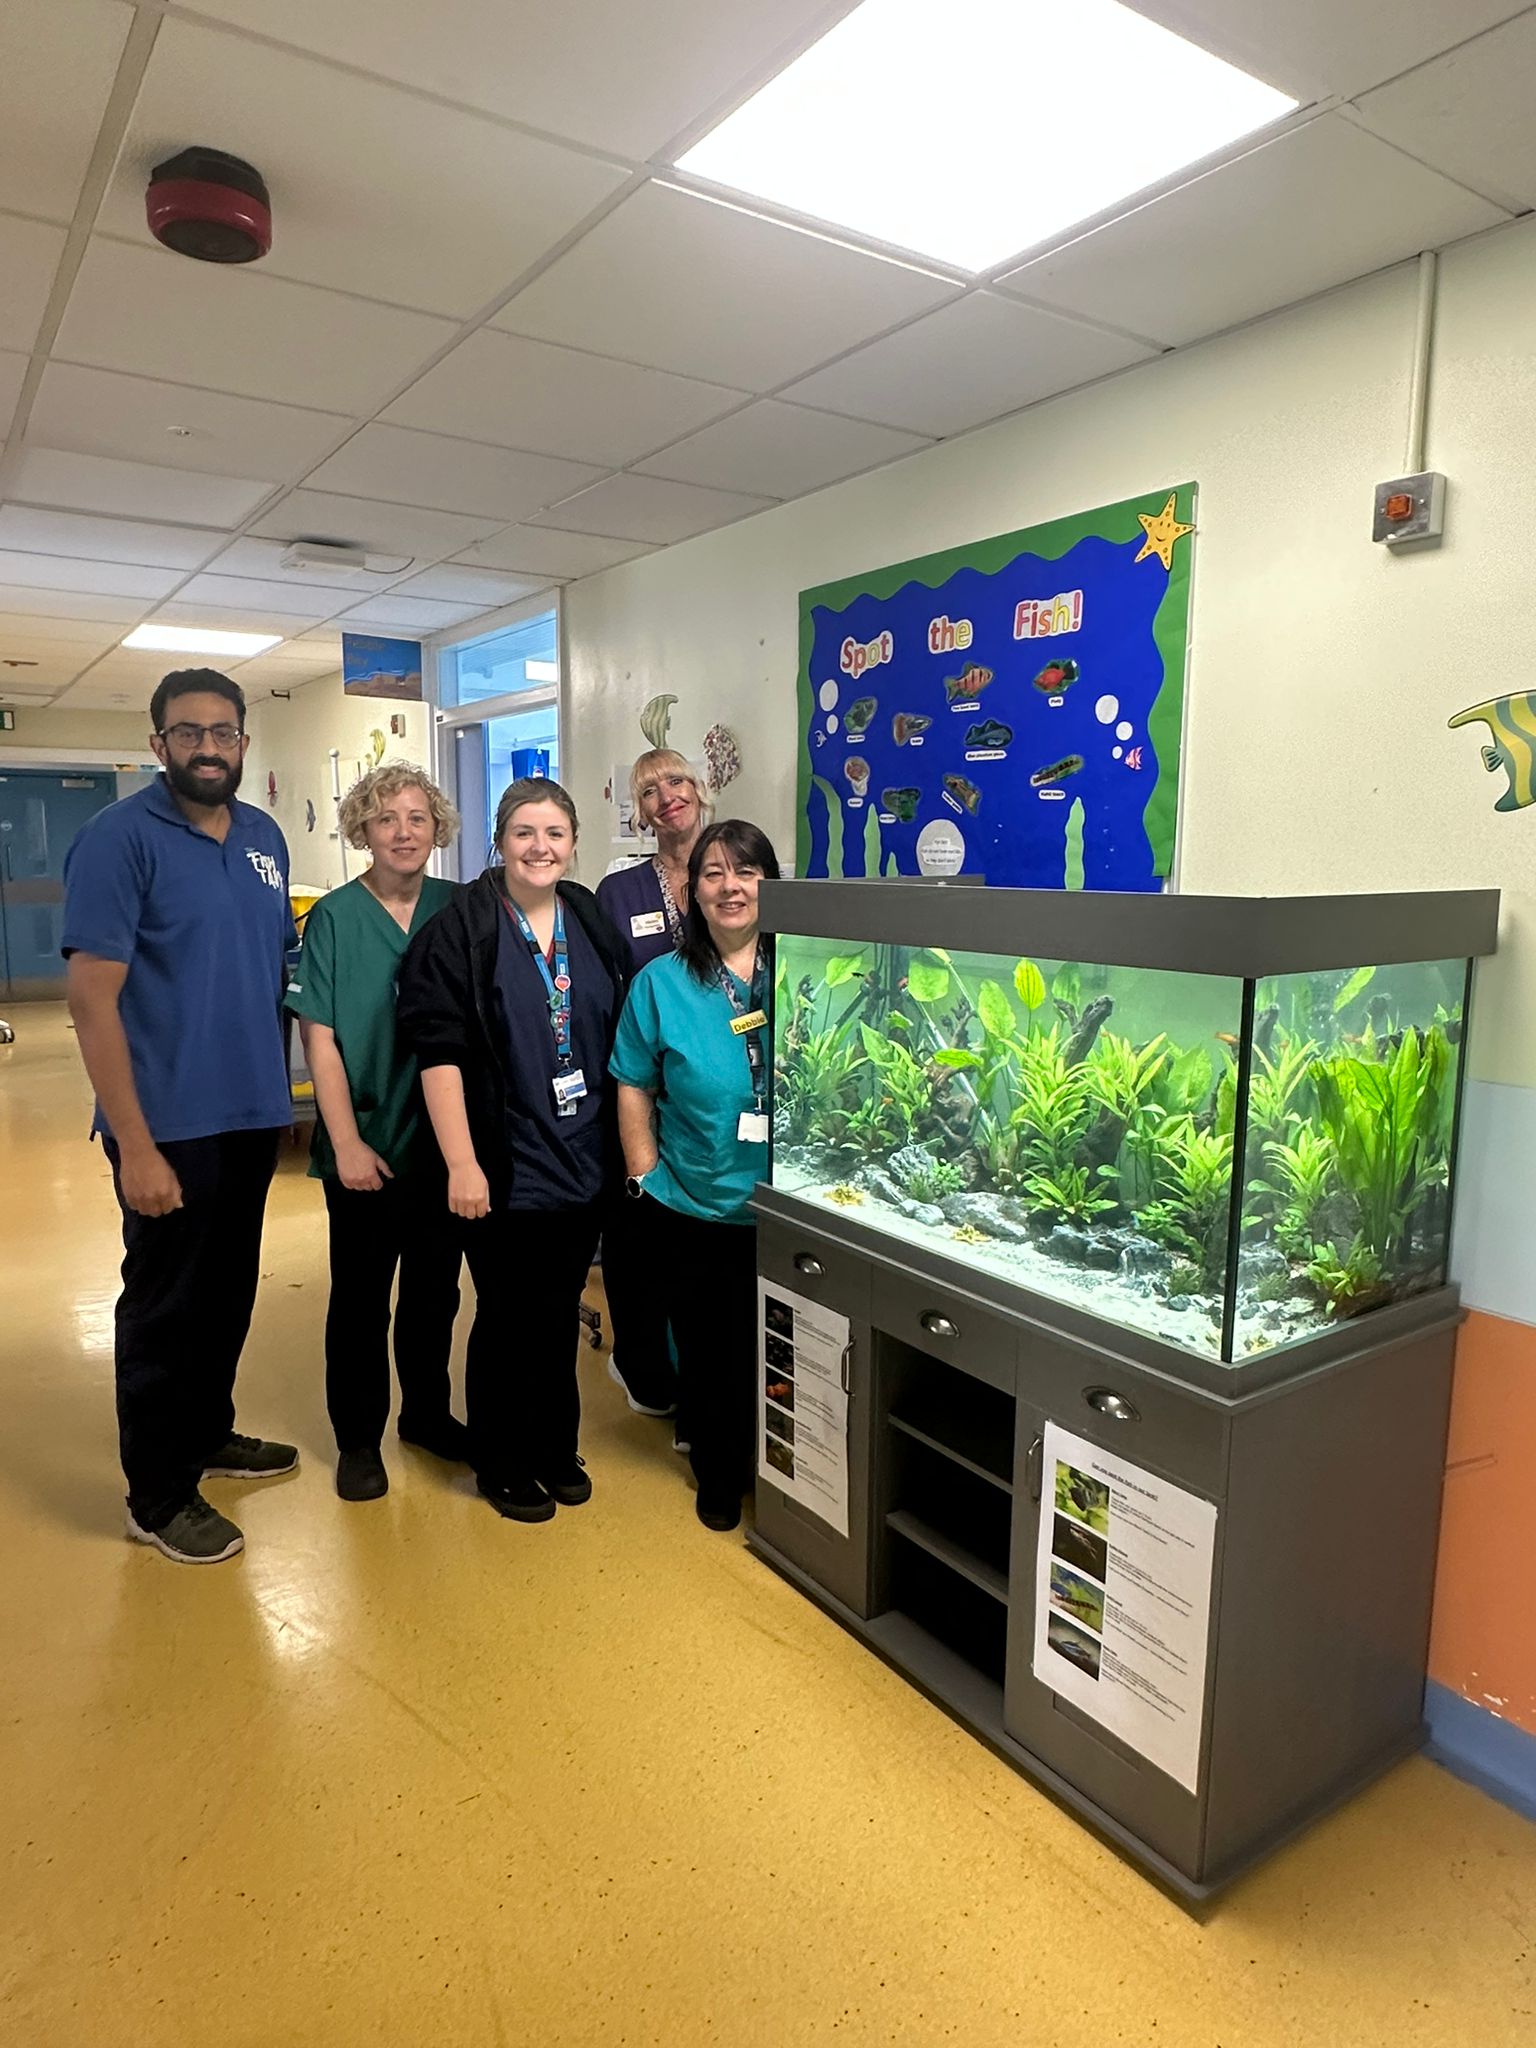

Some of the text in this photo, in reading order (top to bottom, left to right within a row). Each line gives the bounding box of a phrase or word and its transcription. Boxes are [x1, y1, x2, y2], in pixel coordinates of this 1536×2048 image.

[841, 591, 1081, 676] Spot the Fish!
[734, 1015, 765, 1032] Debbie
